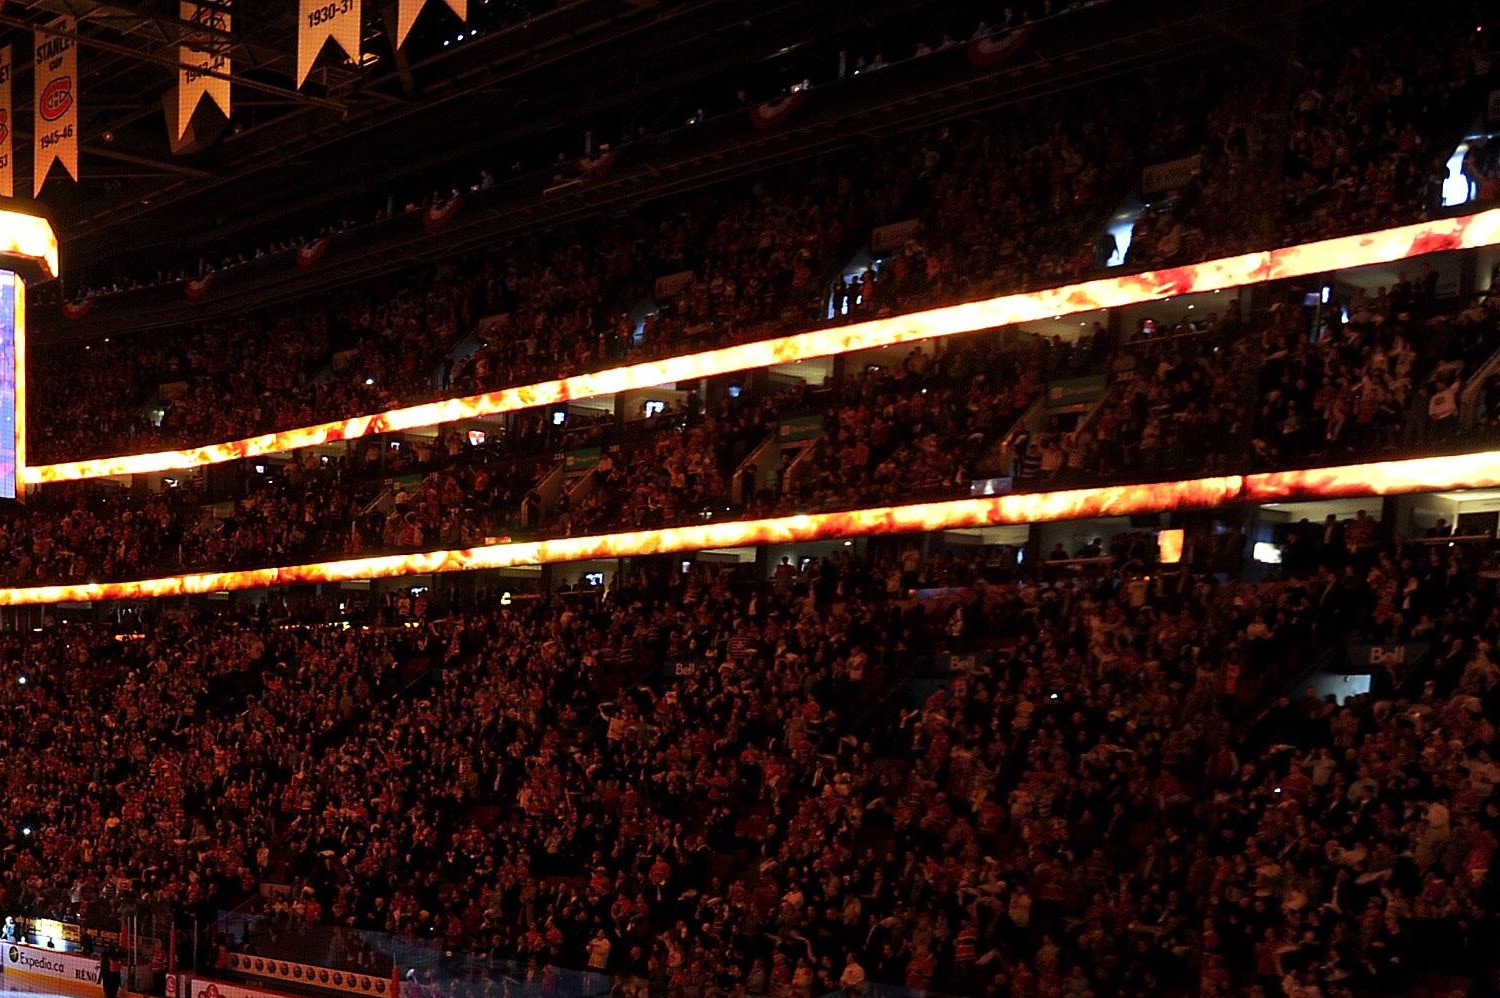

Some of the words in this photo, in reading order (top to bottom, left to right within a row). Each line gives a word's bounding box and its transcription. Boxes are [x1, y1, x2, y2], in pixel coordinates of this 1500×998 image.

[49, 57, 63, 71] CUP
[40, 124, 73, 150] 1945-46
[20, 953, 64, 972] Expedia.ca
